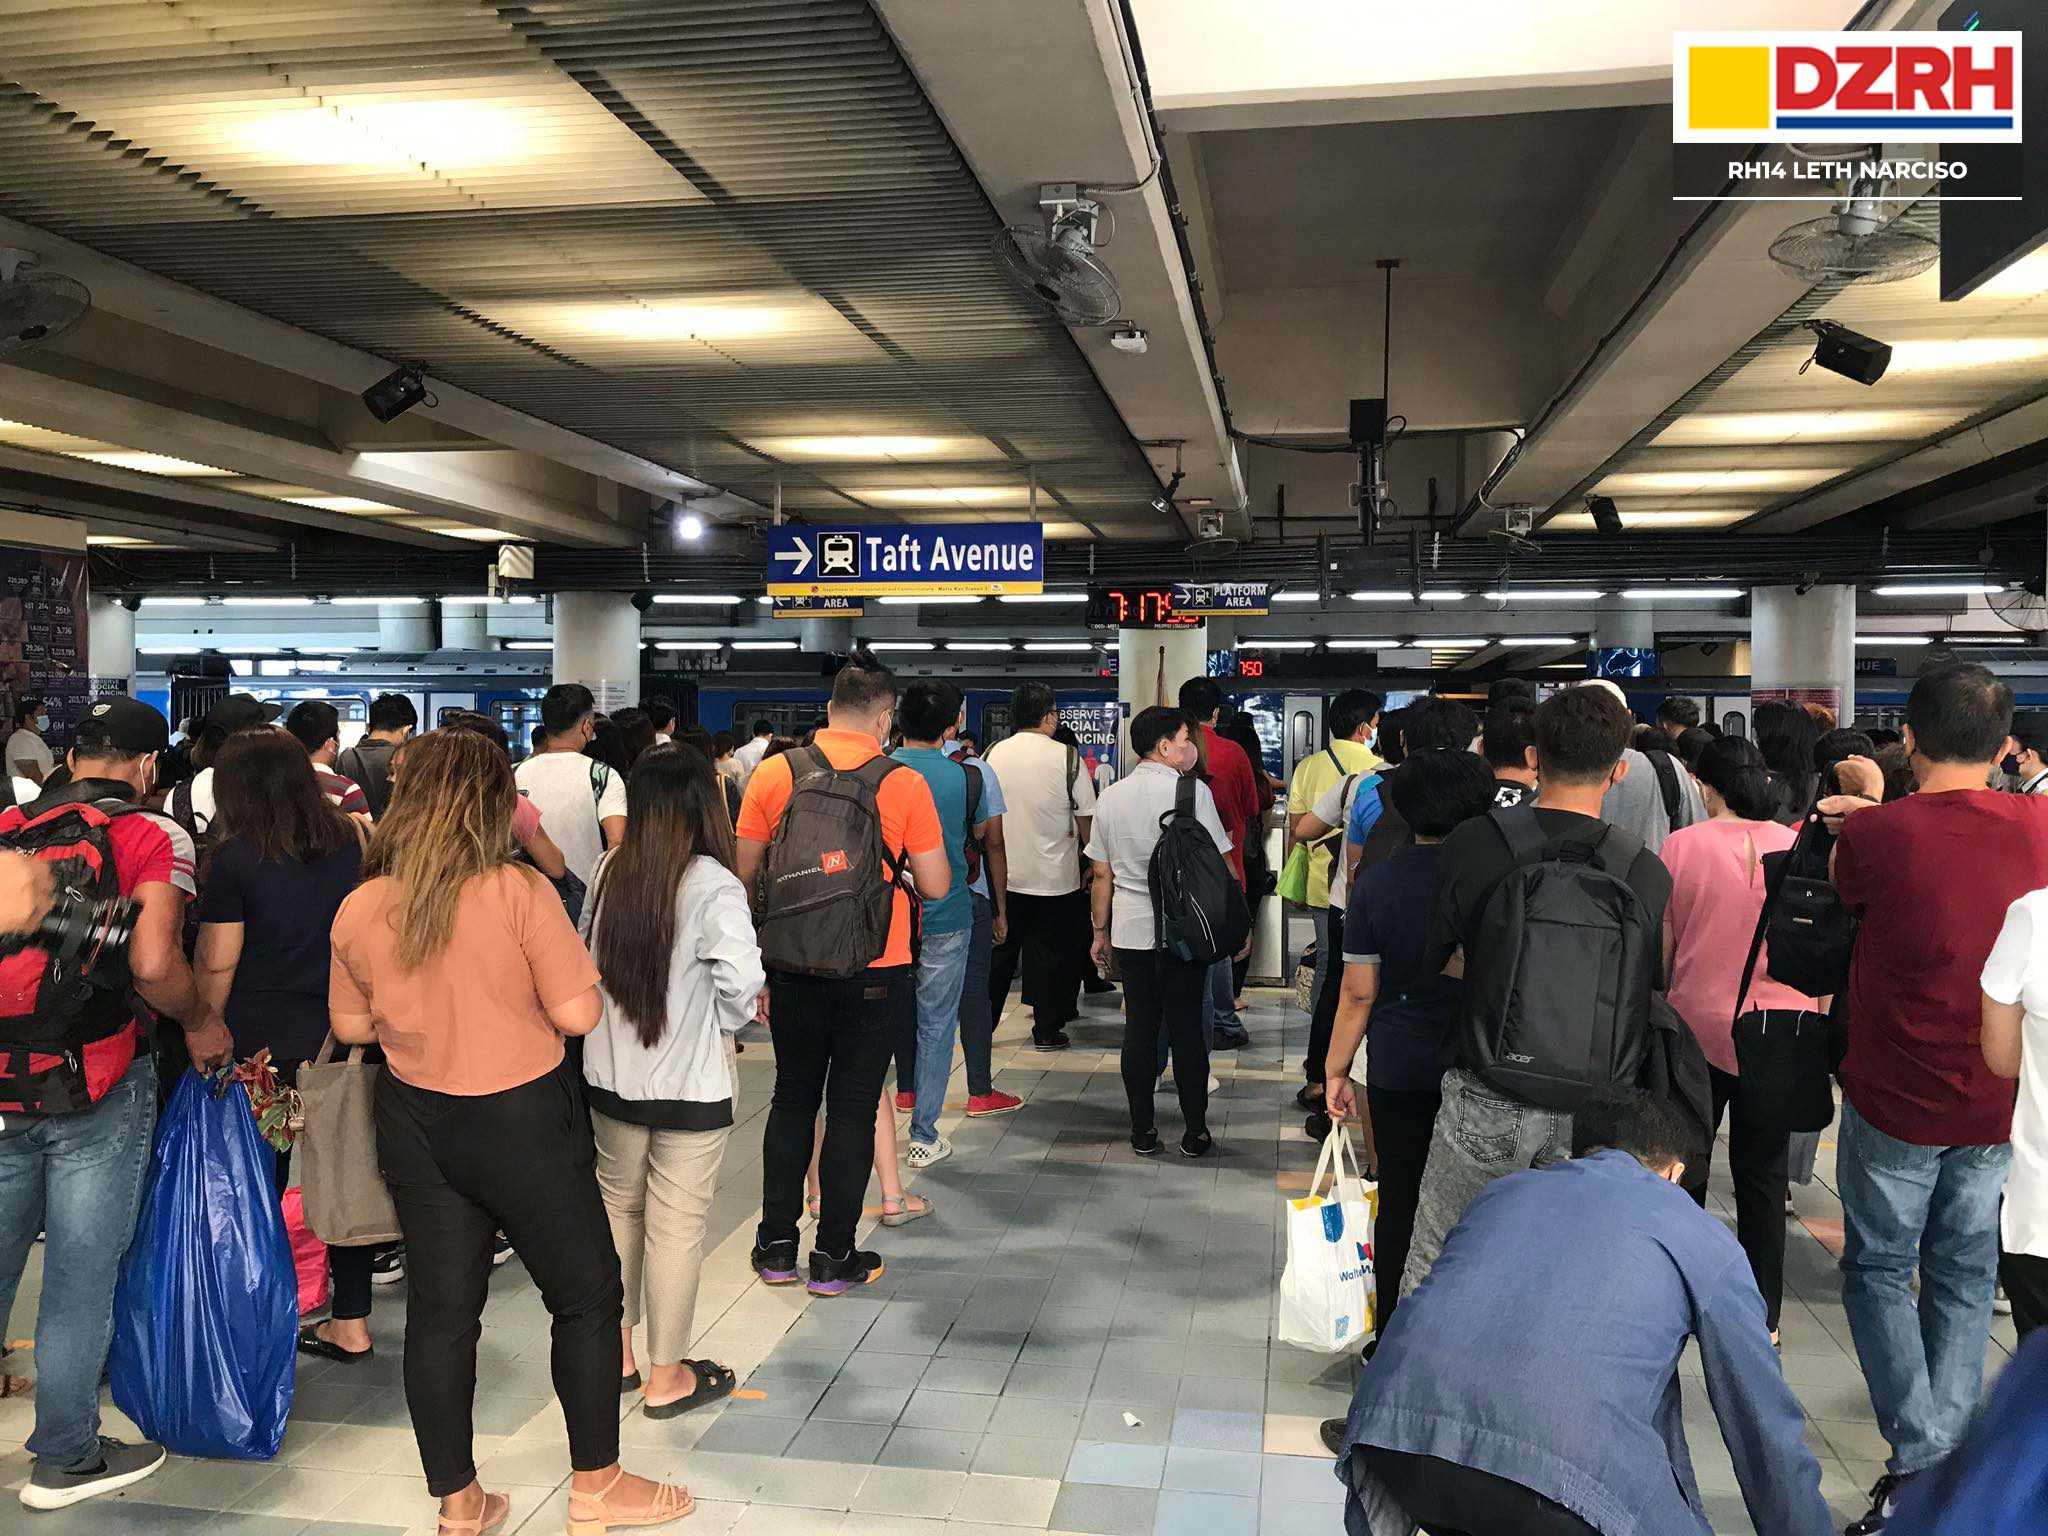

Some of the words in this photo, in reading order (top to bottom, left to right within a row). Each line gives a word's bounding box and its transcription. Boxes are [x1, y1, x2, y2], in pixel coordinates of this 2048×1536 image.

[865, 533, 922, 573] Taft
[930, 536, 1034, 573] Avenue
[1214, 585, 1267, 597] PLATFORM
[823, 598, 849, 608] AREA
[1225, 597, 1253, 607] AREA
[1855, 660, 1881, 671] NUE
[1060, 709, 1101, 720] BSERVE
[1061, 720, 1100, 732] CIAL
[1505, 1051, 1536, 1063] acer
